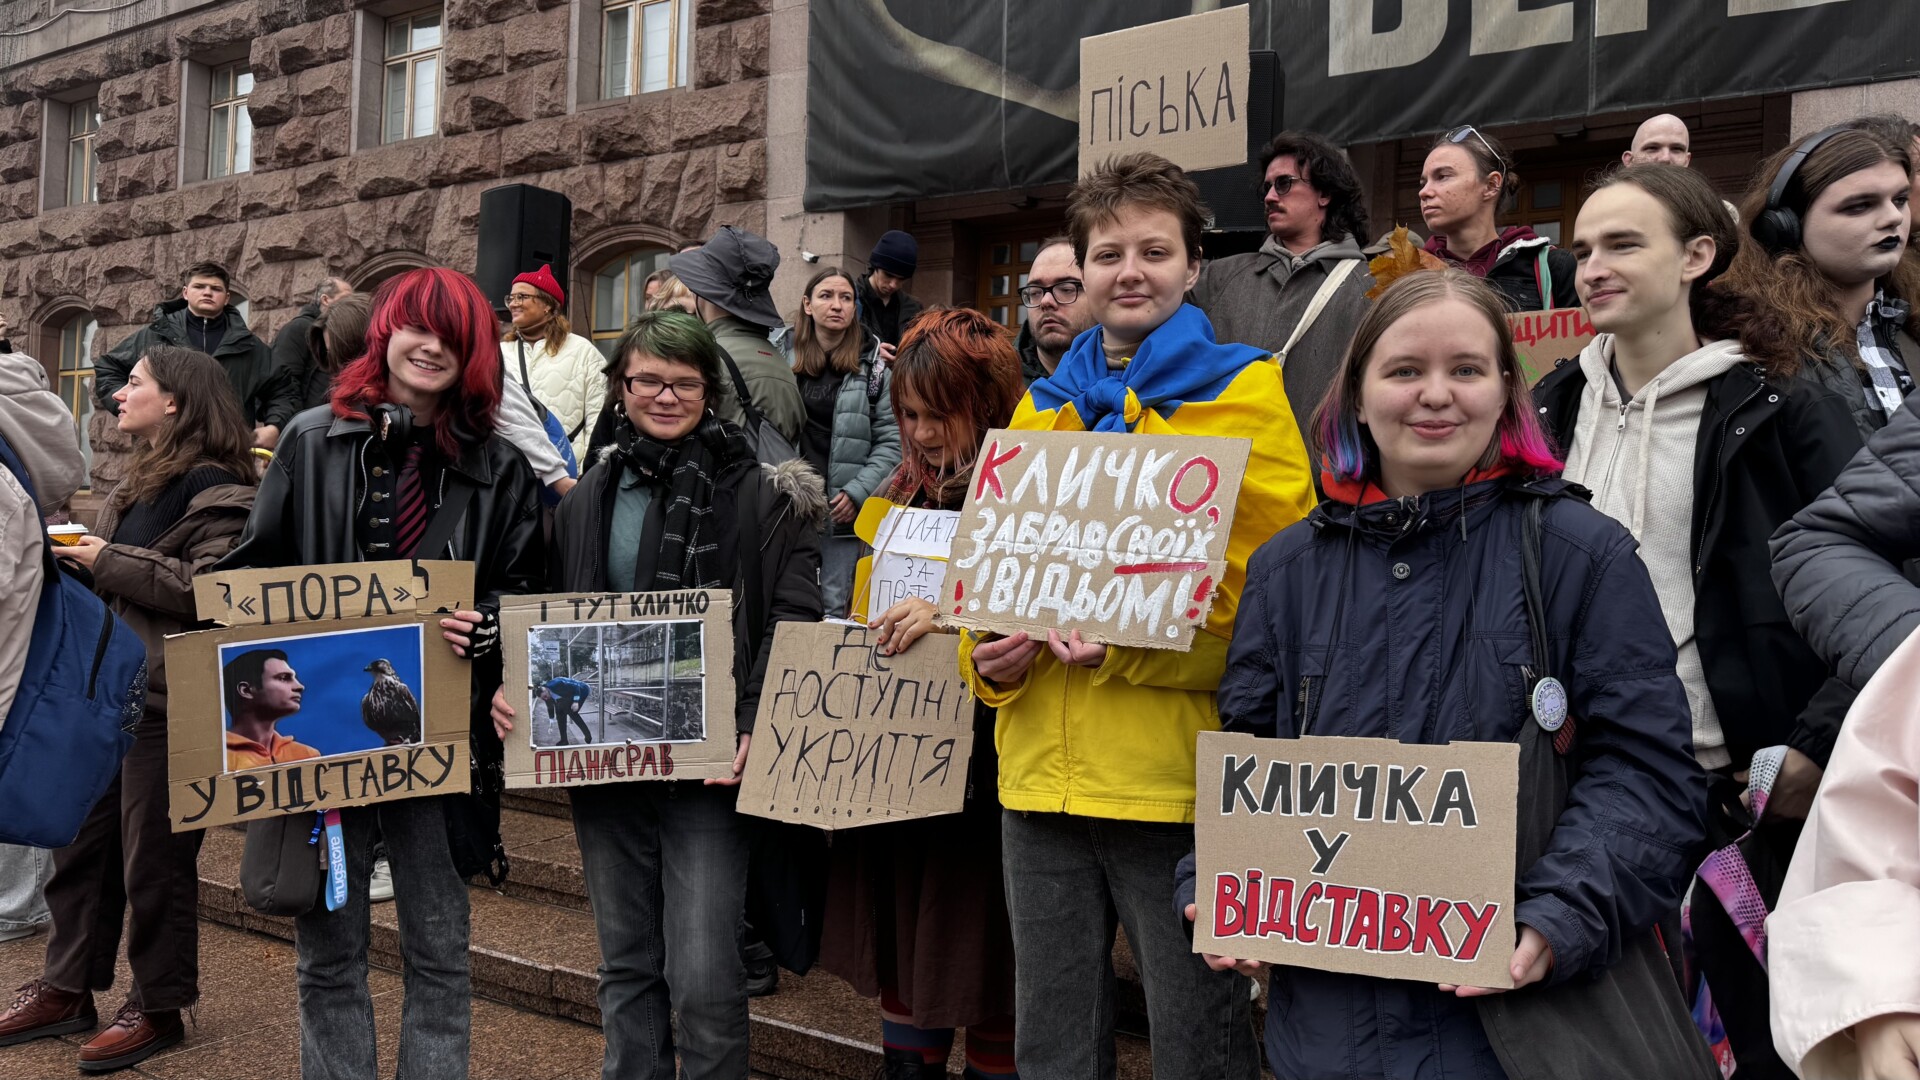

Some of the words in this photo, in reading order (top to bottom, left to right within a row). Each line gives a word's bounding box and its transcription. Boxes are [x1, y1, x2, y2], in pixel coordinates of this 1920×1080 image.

[975, 438, 1221, 528] КЛИЧКО,
[237, 572, 411, 625] «ПОРА»
[904, 557, 935, 582] ЗА
[568, 594, 623, 621] ТУТ
[630, 591, 710, 618] КЛИЧКО
[179, 777, 217, 825] У
[232, 744, 455, 817] ВІДСТАВКУ
[534, 742, 675, 785] ПІДНАСРАВ
[768, 723, 956, 789] УКРИТТЯ
[1220, 754, 1478, 828] КЛИЧКА
[331, 836, 346, 904] drugstore
[1303, 827, 1351, 875] У
